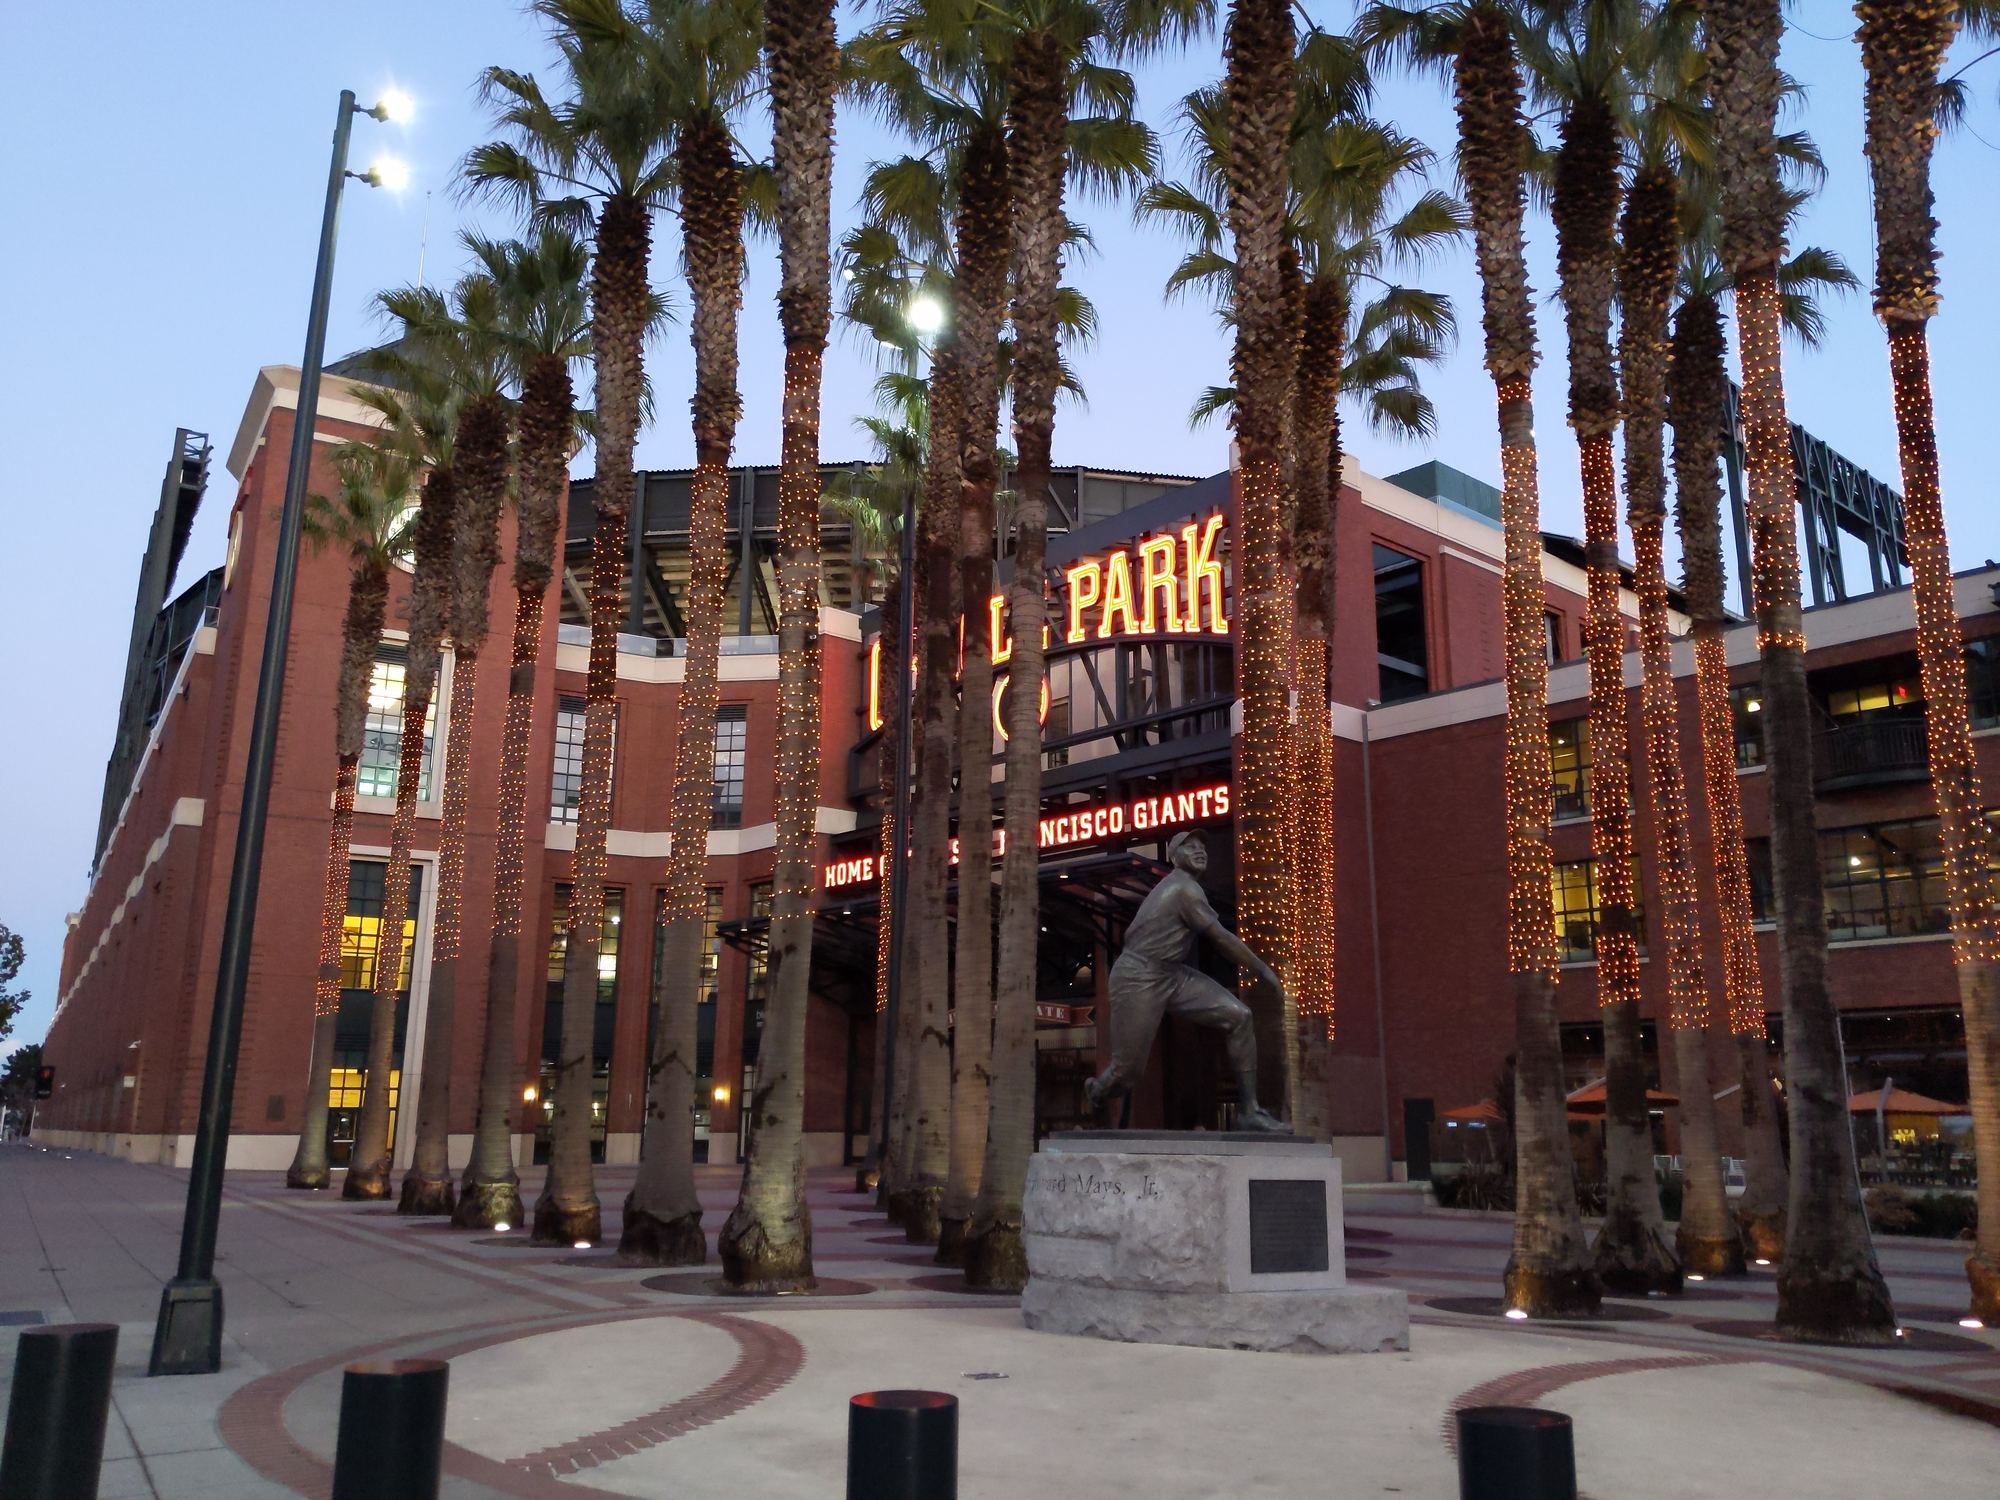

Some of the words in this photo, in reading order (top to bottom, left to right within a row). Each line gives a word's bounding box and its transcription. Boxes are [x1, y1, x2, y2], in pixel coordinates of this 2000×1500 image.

[1067, 514, 1229, 644] PARK
[825, 857, 873, 888] HOME
[1037, 806, 1124, 848] NCISCO
[1133, 785, 1230, 830] GIANTS
[1035, 1005, 1065, 1020] ATE
